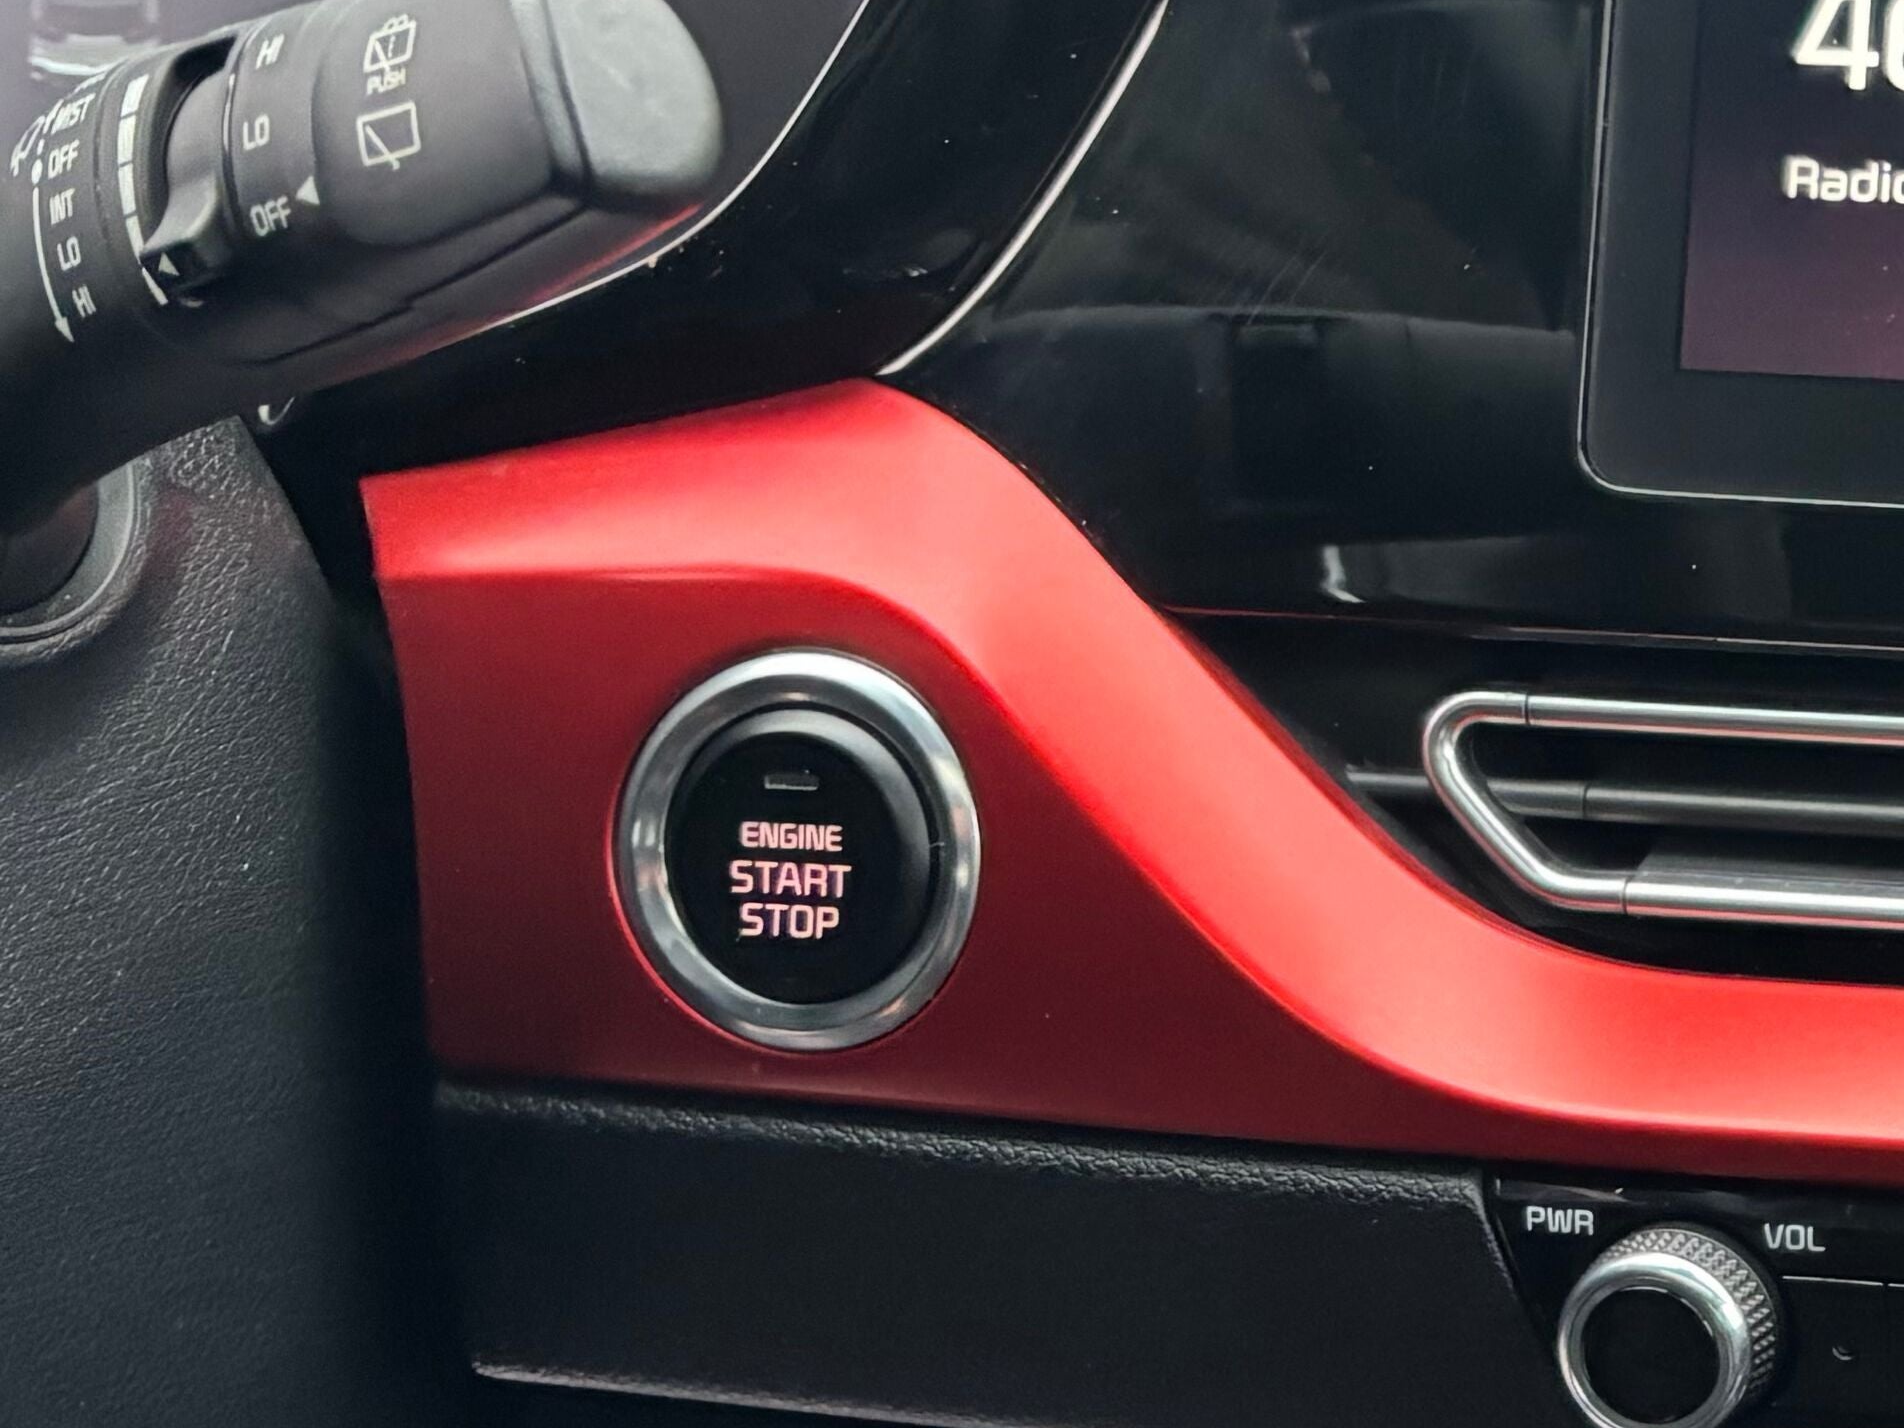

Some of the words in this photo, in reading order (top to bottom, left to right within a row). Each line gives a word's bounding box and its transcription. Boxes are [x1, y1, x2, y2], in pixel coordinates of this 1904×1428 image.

[256, 34, 285, 70] HI
[366, 72, 406, 95] PUSH
[243, 114, 269, 150] LO
[48, 140, 79, 178] OFF
[50, 188, 75, 224] INT
[250, 195, 291, 236] OFF
[57, 236, 81, 270] LO
[72, 286, 96, 317] HI
[741, 822, 842, 851] ENGINE
[730, 860, 851, 897] START
[741, 903, 839, 938] STOP
[1526, 1206, 1593, 1235] PWR
[1764, 1223, 1825, 1251] VOL
